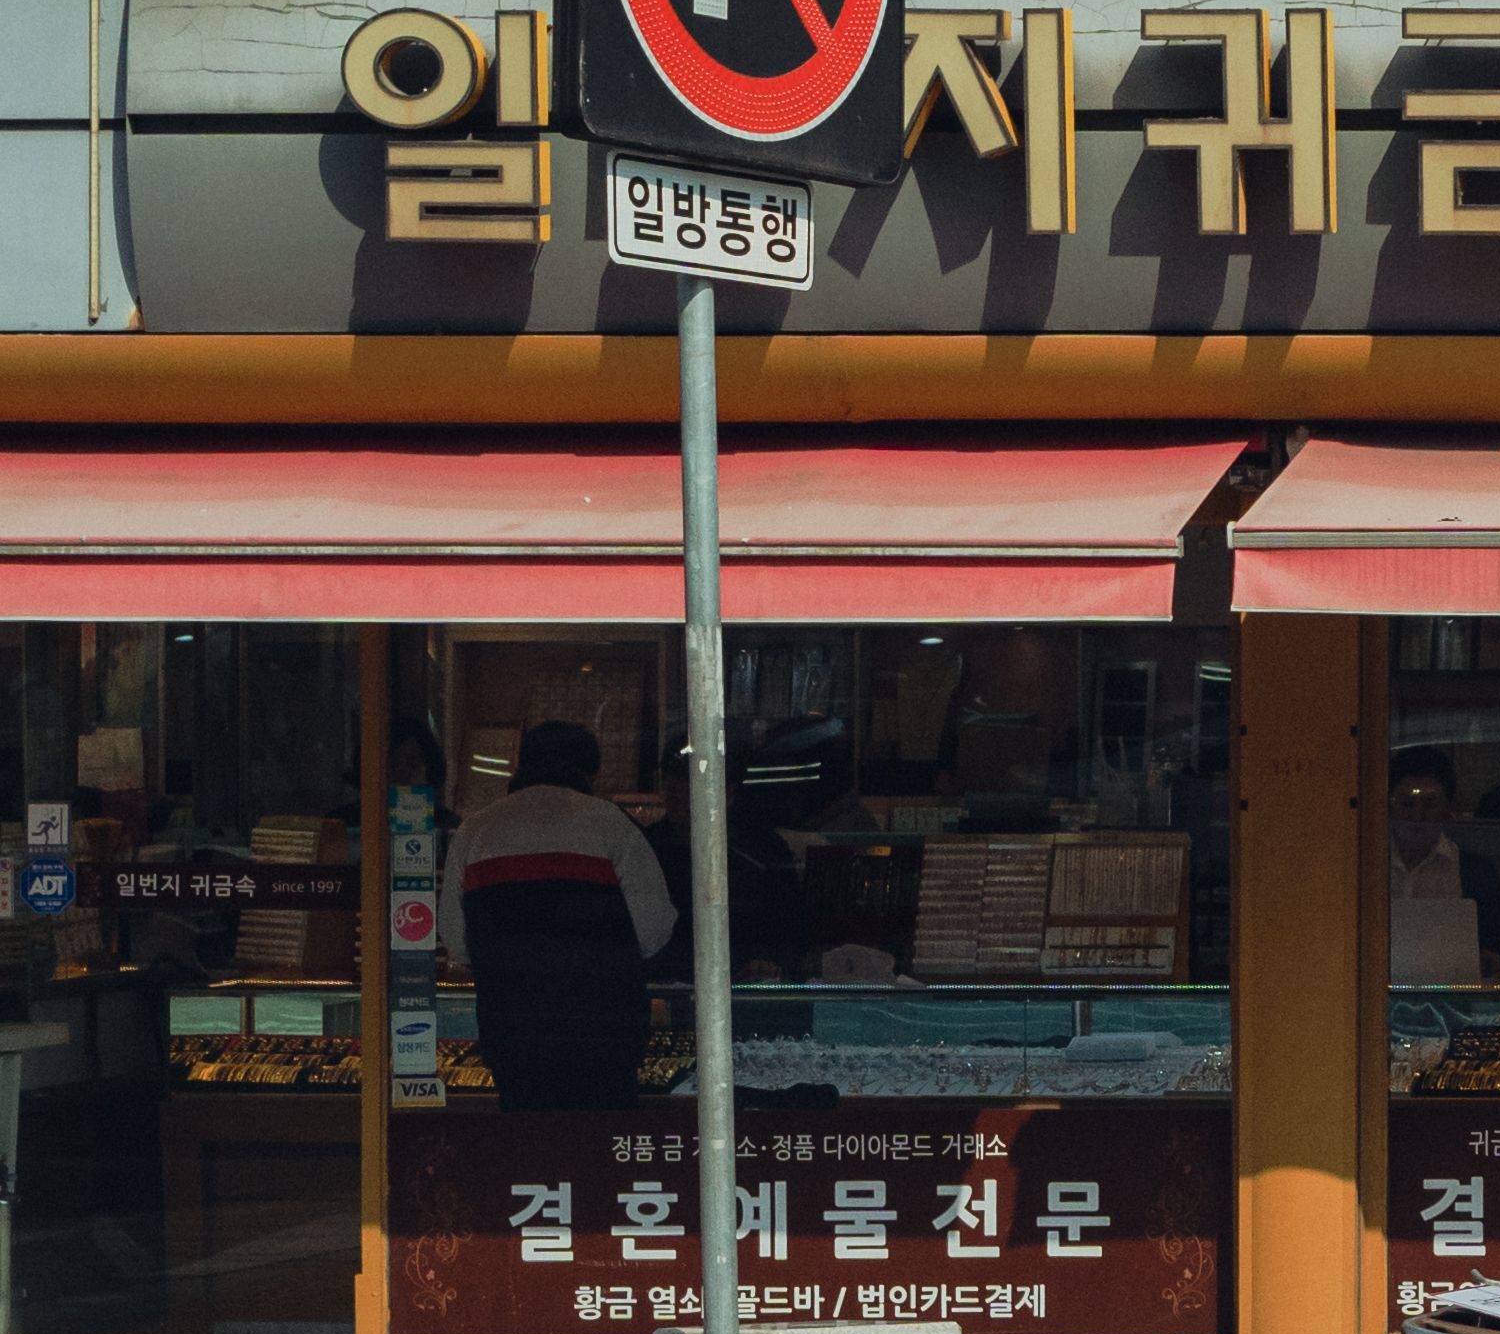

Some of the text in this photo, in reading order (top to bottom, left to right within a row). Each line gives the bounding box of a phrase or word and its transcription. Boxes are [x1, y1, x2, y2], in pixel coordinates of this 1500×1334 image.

[625, 173, 801, 264] 일방통행
[28, 874, 68, 897] ADT
[116, 872, 344, 899] 일번지 귀금속 since 1997
[400, 1082, 439, 1097] VISA
[611, 1133, 656, 1162] 정품
[661, 1134, 686, 1161] 금
[823, 1133, 935, 1161] 다이아몬드
[941, 1132, 1009, 1160] 거래소
[573, 1284, 638, 1321] 황금
[857, 1282, 1047, 1319] 법인카드결제
